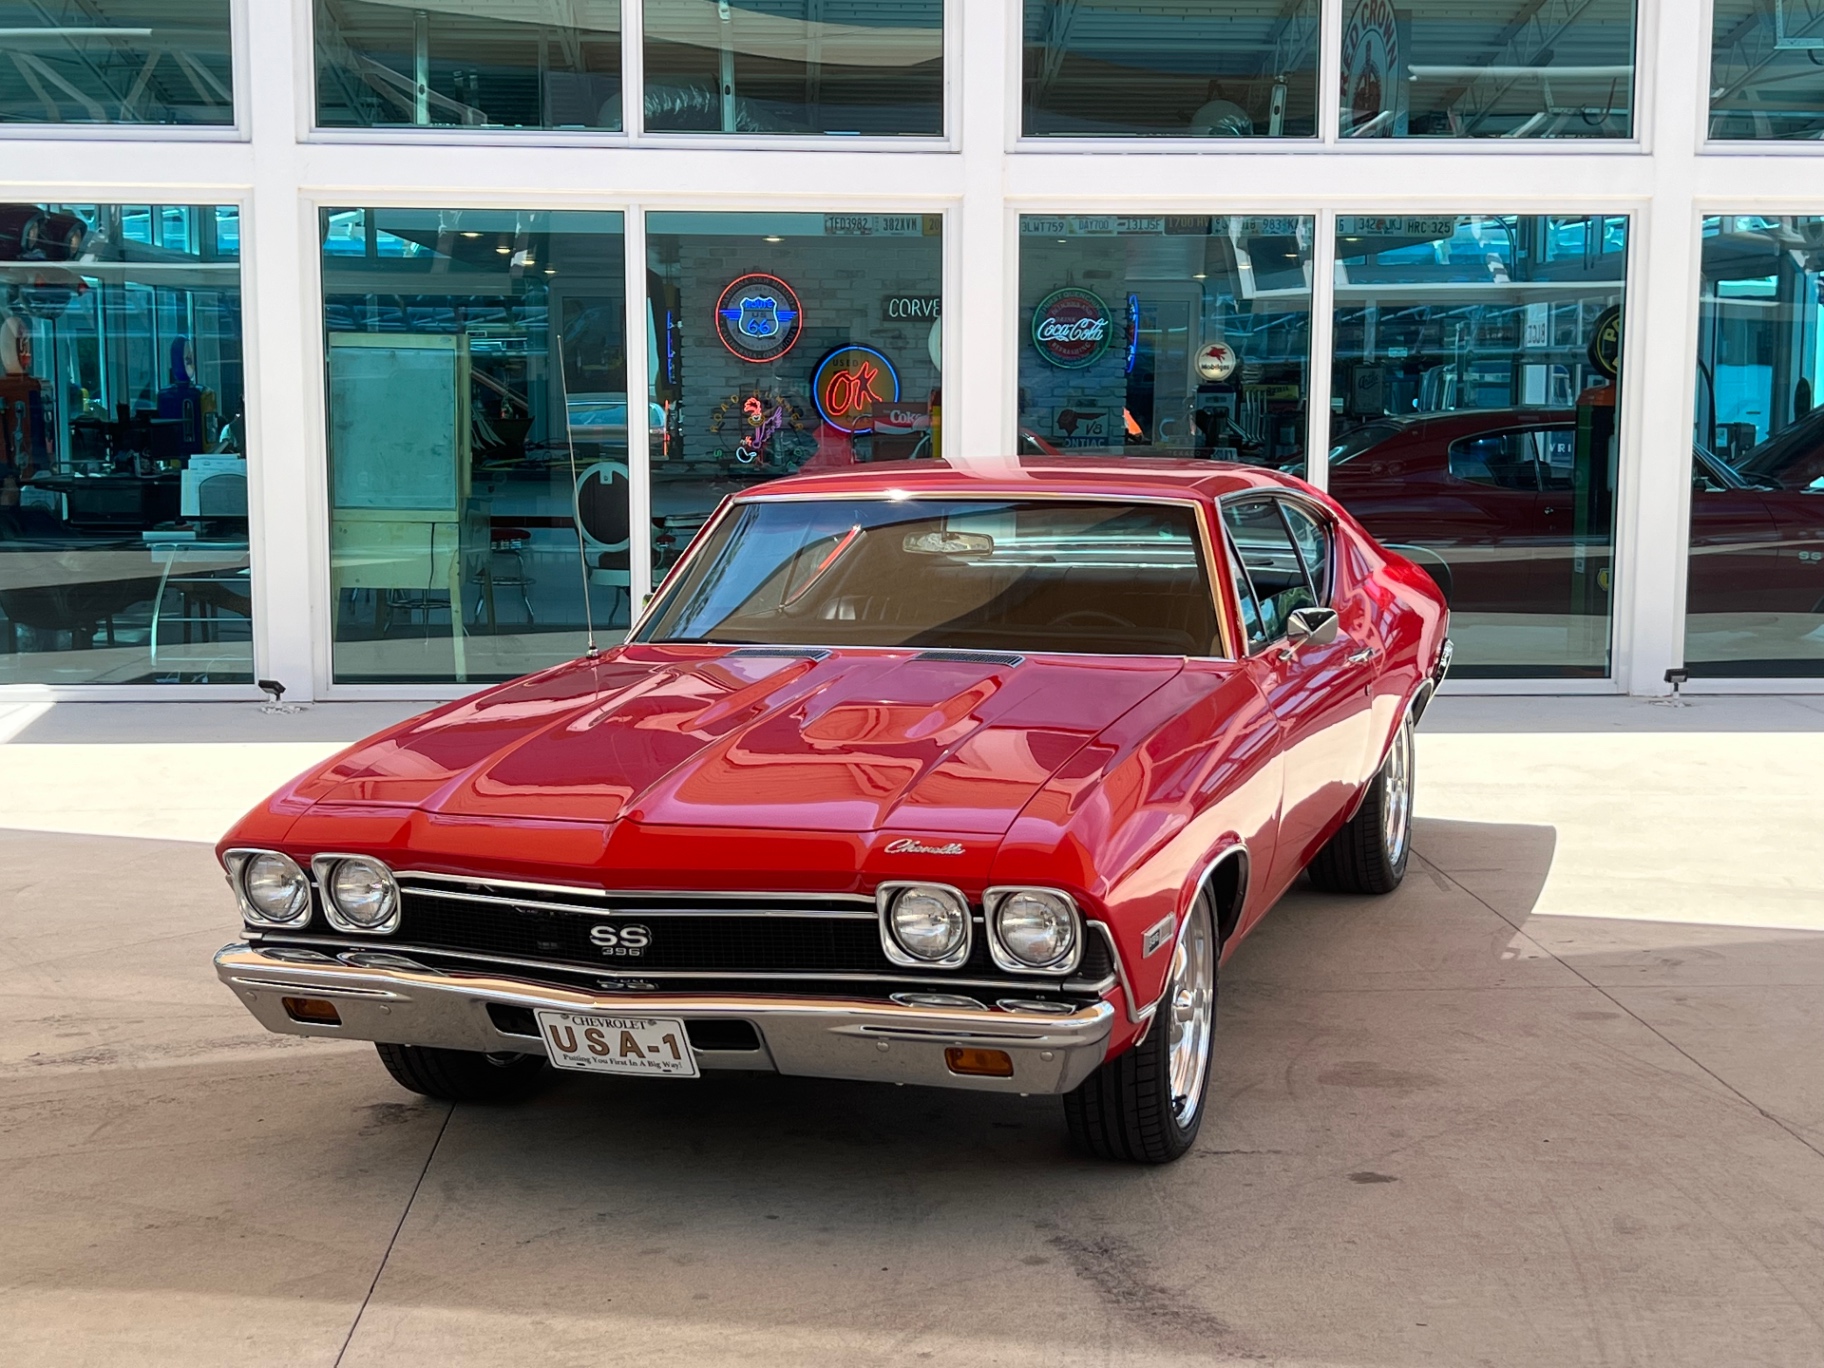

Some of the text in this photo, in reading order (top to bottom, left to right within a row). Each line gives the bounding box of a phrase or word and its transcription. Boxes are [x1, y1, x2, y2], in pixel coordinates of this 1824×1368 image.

[1361, 0, 1397, 72] CROWN
[745, 299, 774, 309] ROUTE
[747, 318, 770, 334] 66
[1037, 317, 1109, 342] Coca-Cola
[832, 359, 859, 367] USED
[826, 361, 883, 417] OK
[1086, 423, 1103, 436] V8
[1064, 438, 1105, 448] ONTIAC
[590, 925, 649, 948] SS
[602, 947, 641, 957] 396
[572, 1015, 647, 1030] CHEVROLET
[549, 1024, 682, 1060] USA-1
[563, 1053, 591, 1064] Putting
[593, 1056, 609, 1064] You
[609, 1057, 628, 1066] First
[647, 1061, 661, 1069] Big
[662, 1061, 682, 1070] Way!
